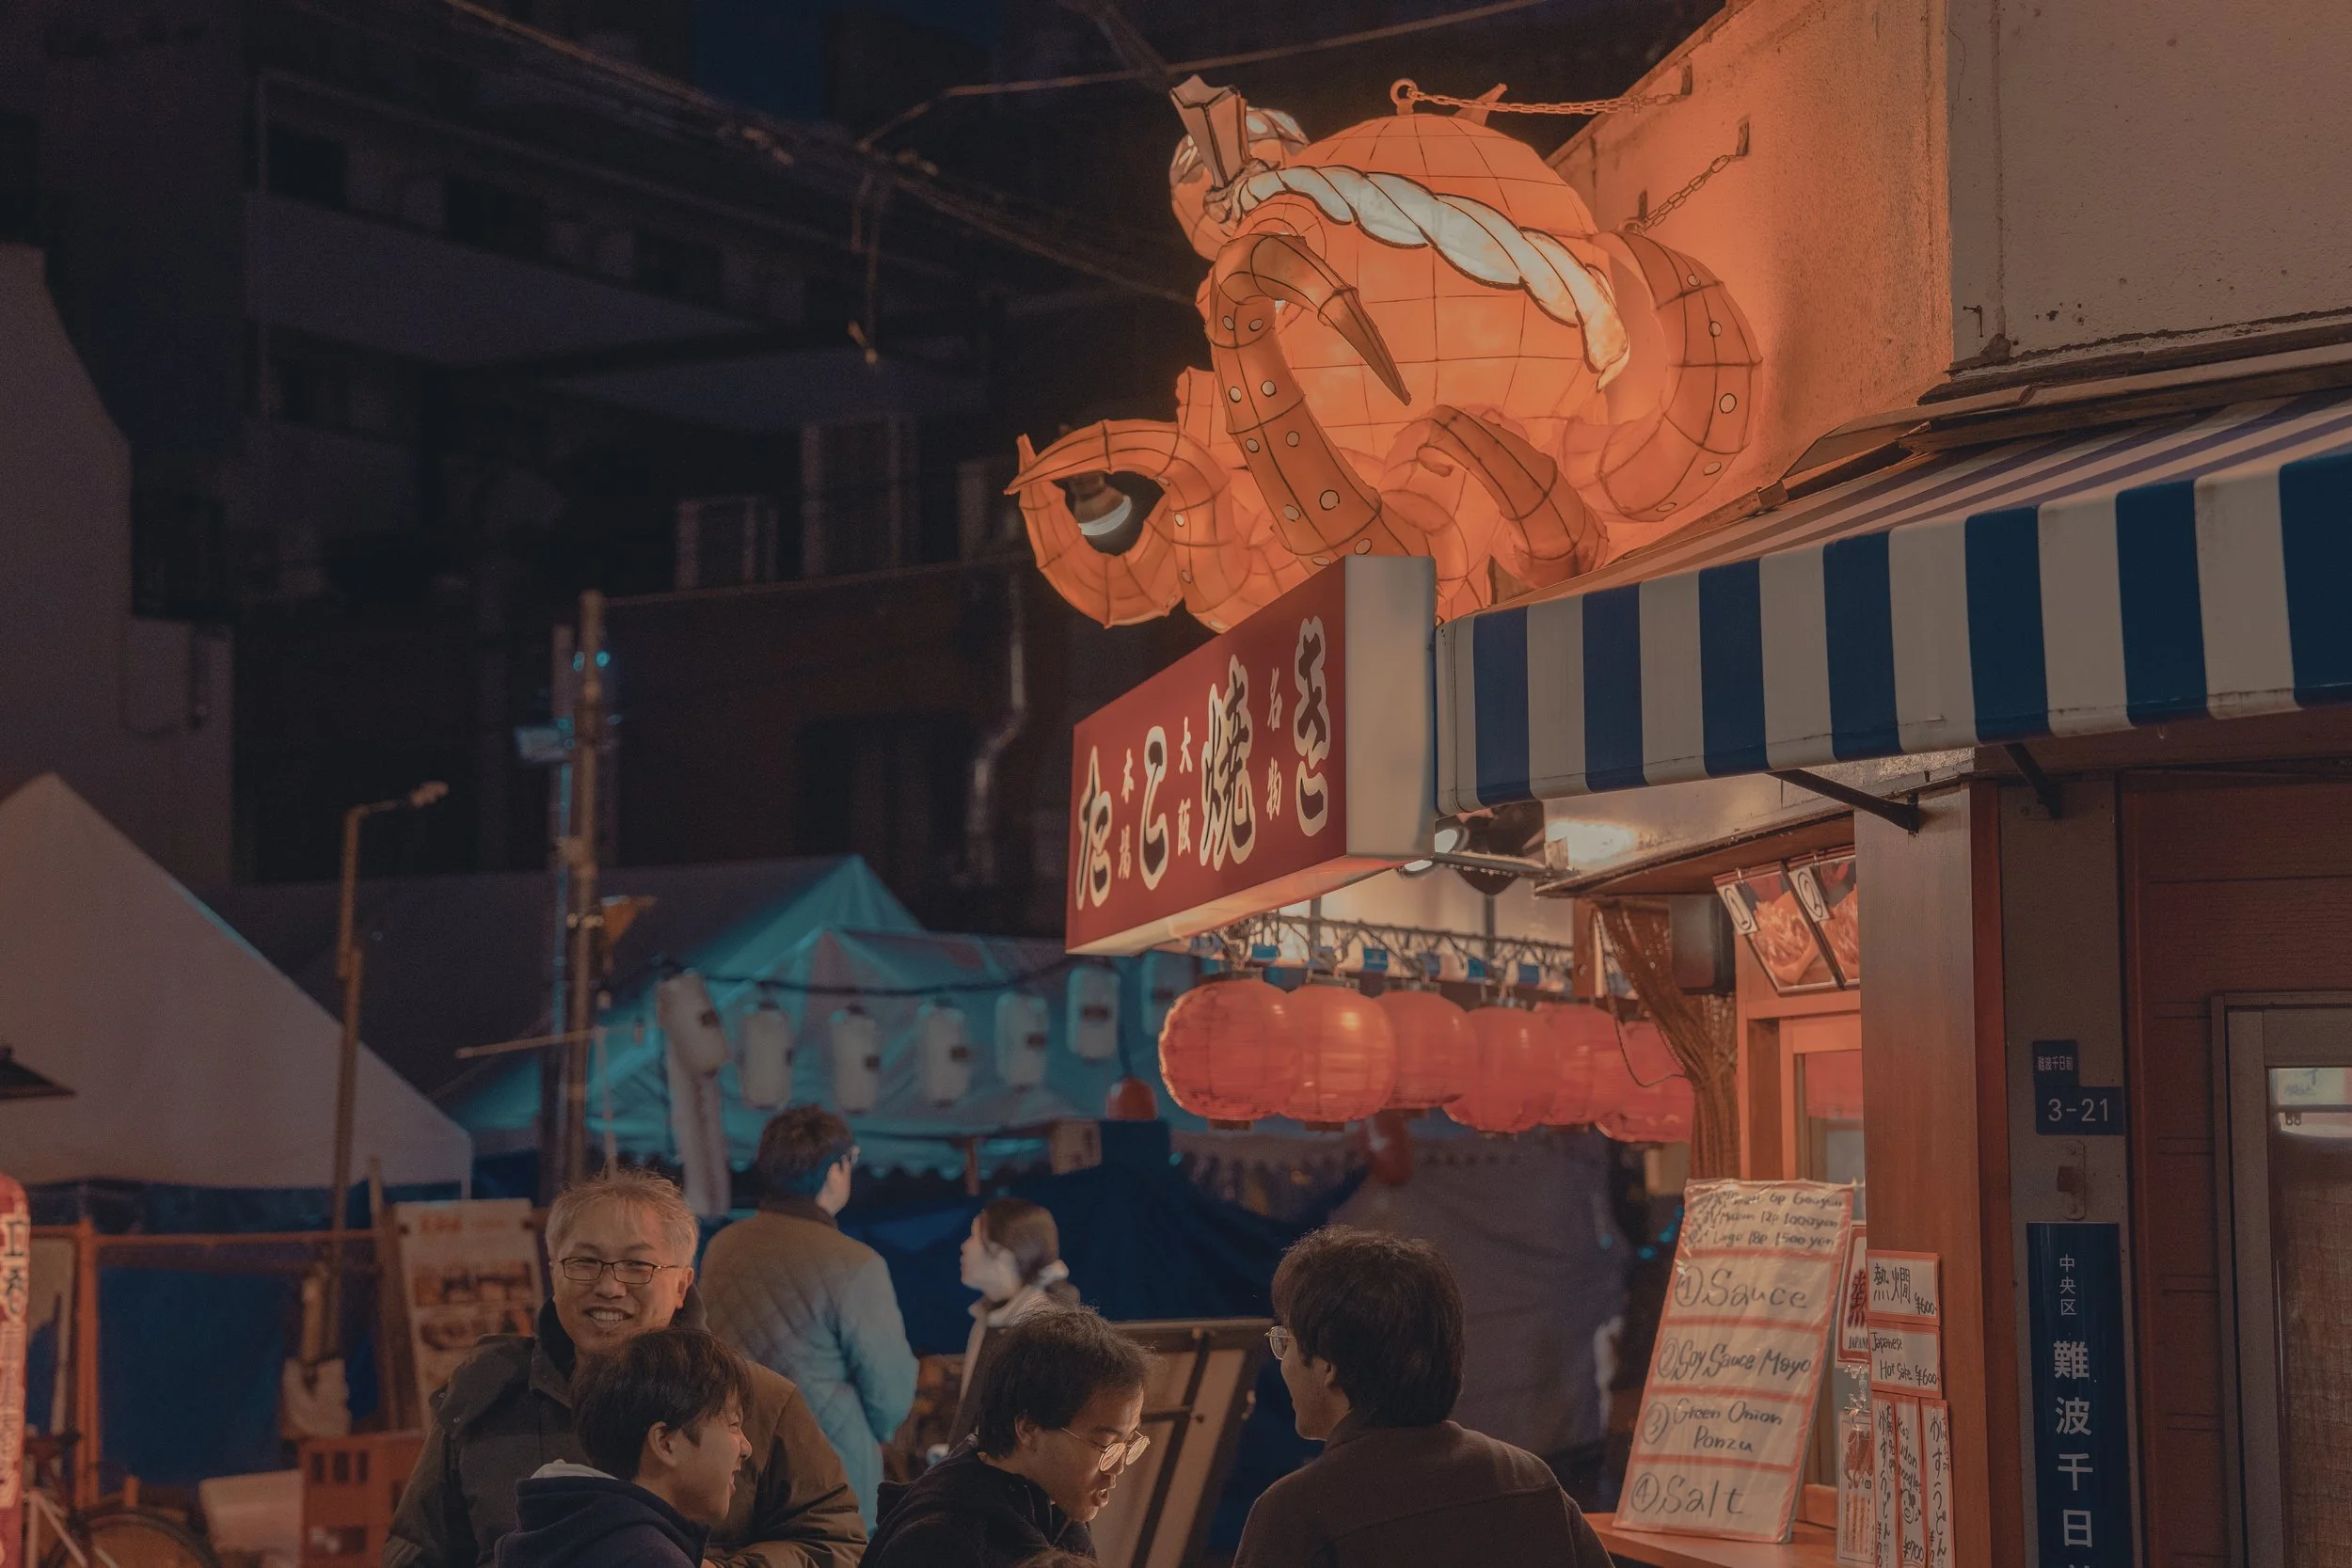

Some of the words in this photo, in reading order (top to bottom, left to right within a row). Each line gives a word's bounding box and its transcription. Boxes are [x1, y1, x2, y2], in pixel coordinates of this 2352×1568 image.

[1267, 667, 1283, 820] 名物
[1177, 716, 1193, 857] 大阪
[2048, 1098, 2107, 1122] 3-21
[1702, 1269, 1807, 1308] Sauce
[2059, 1254, 2077, 1316] 中央区
[1672, 1339, 1708, 1381] Soy
[1702, 1342, 1755, 1378] Sauce
[1757, 1349, 1812, 1381] Mayo
[1880, 1359, 1895, 1379] Hot
[1674, 1397, 1721, 1424] Green
[1728, 1401, 1783, 1426] Onion
[1693, 1425, 1753, 1452] Ponzu
[2054, 1340, 2092, 1568] 難波千日
[1655, 1475, 1743, 1517] Salt
